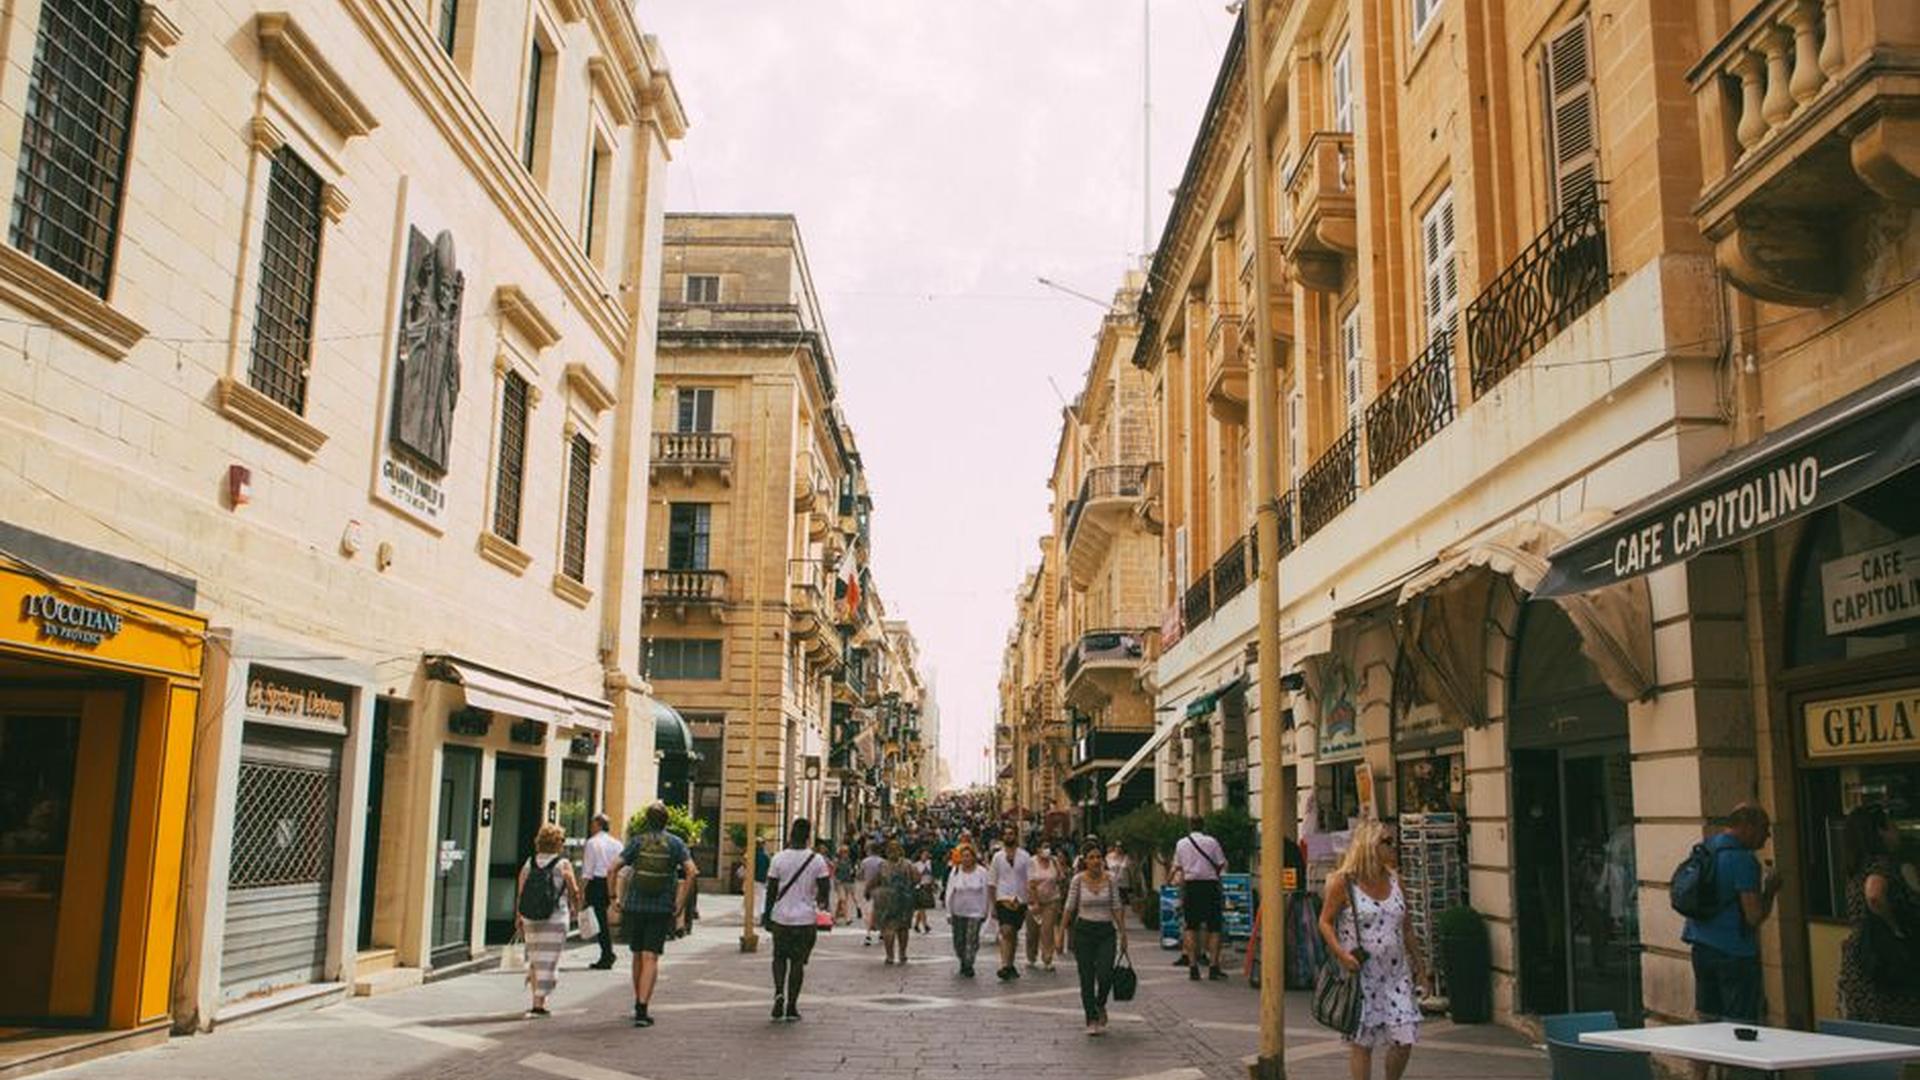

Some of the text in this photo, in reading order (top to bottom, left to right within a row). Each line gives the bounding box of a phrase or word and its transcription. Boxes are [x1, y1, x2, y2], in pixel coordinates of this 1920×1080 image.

[1615, 456, 1818, 577] CAFE CAPITOLINO
[1862, 550, 1902, 583] CAFE
[28, 594, 123, 634] L'OCCITANE
